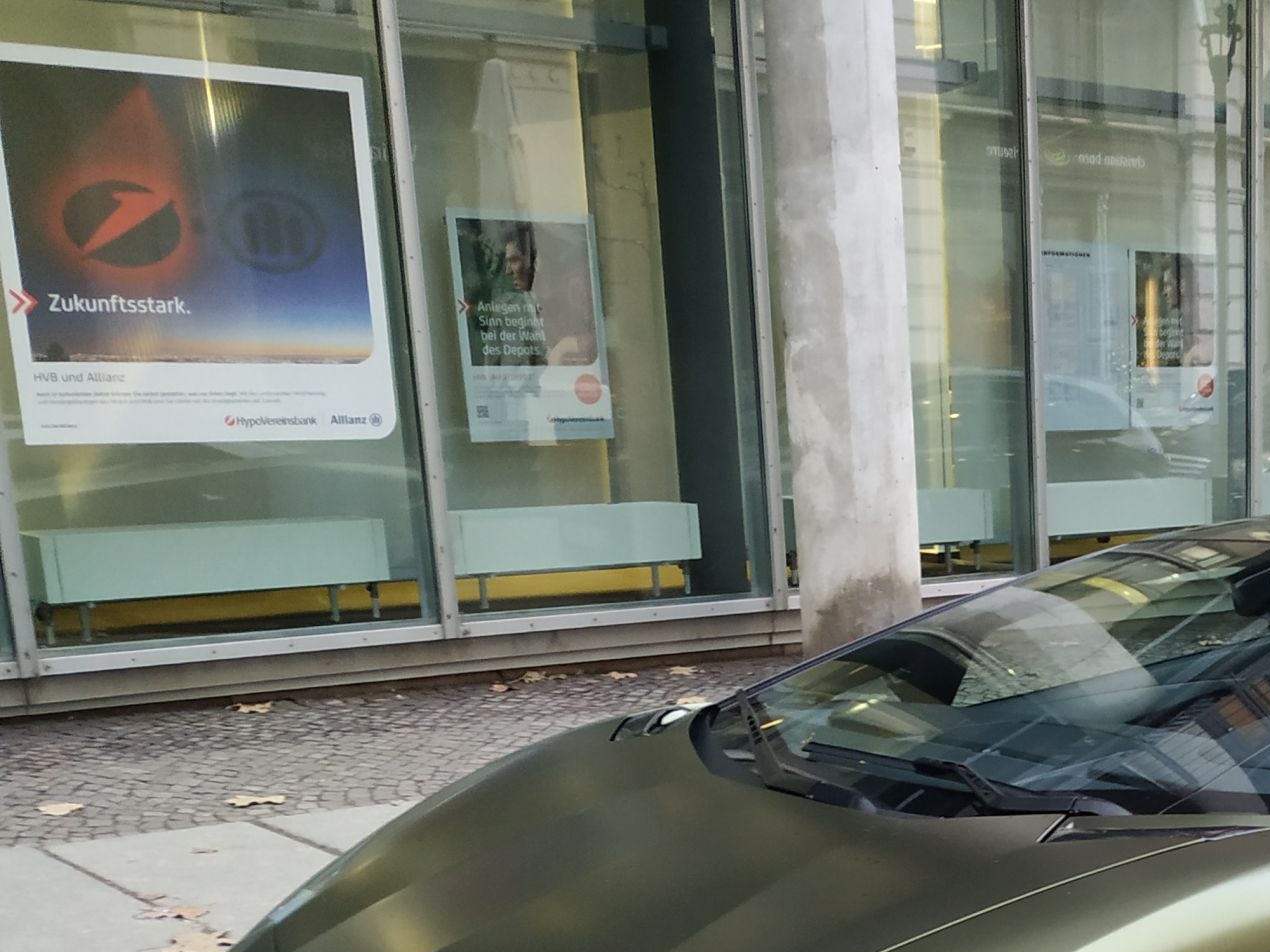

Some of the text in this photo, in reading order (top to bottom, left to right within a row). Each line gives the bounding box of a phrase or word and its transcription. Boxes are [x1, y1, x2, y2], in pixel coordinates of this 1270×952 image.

[48, 293, 191, 315] Zukunftsstark.
[479, 315, 502, 327] Sinn
[481, 329, 497, 341] bei
[499, 329, 517, 341] der
[482, 344, 501, 356] des
[33, 373, 126, 383] HVB und Allianz
[236, 416, 317, 428] HypoVereinsbank
[330, 415, 367, 425] Allianz
